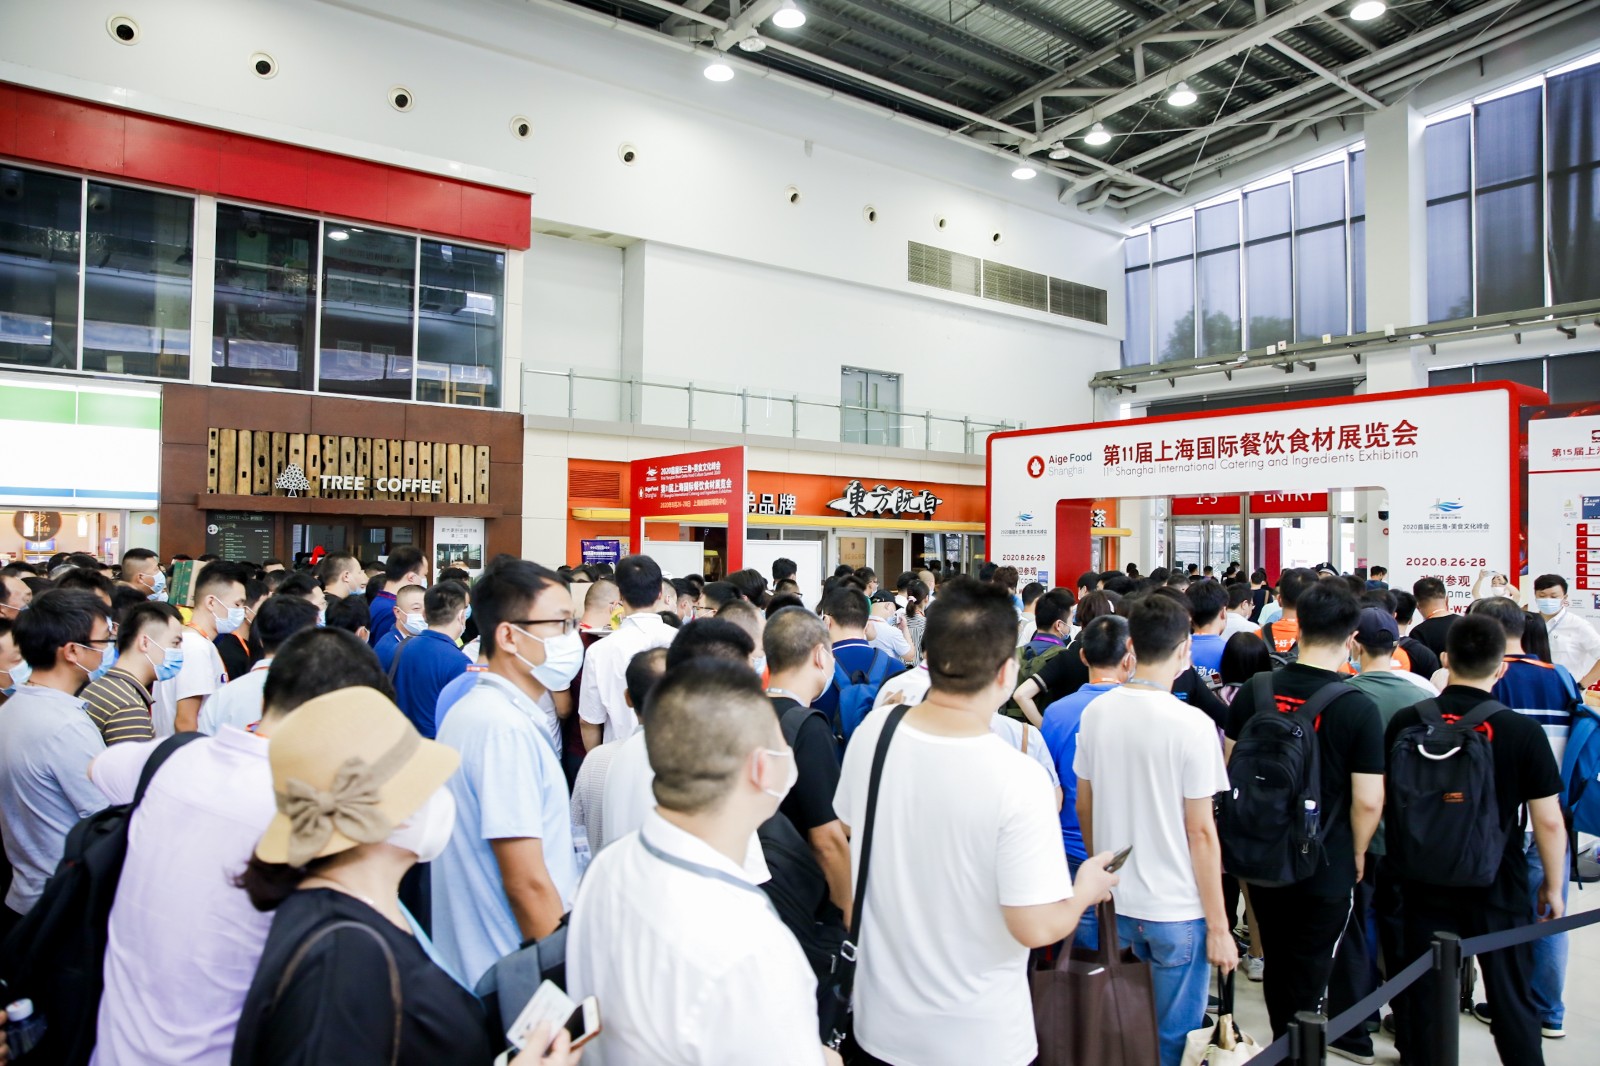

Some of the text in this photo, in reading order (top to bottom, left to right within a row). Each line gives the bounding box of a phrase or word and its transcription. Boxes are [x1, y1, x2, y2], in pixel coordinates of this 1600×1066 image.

[1103, 419, 1419, 467] 第11届上海国际餐饮食材展览会
[1048, 464, 1085, 478] Shanghai
[1115, 465, 1156, 478] Shanghai
[1158, 460, 1217, 474] International
[1219, 456, 1264, 471] Catering
[1267, 455, 1289, 467] and
[1292, 452, 1355, 468] Ingredients
[1358, 448, 1419, 462] Exhibition
[320, 474, 442, 494] TREE COFFEE
[1264, 492, 1313, 503] ENTRY
[1406, 557, 1487, 567] 2020.8.26-28
